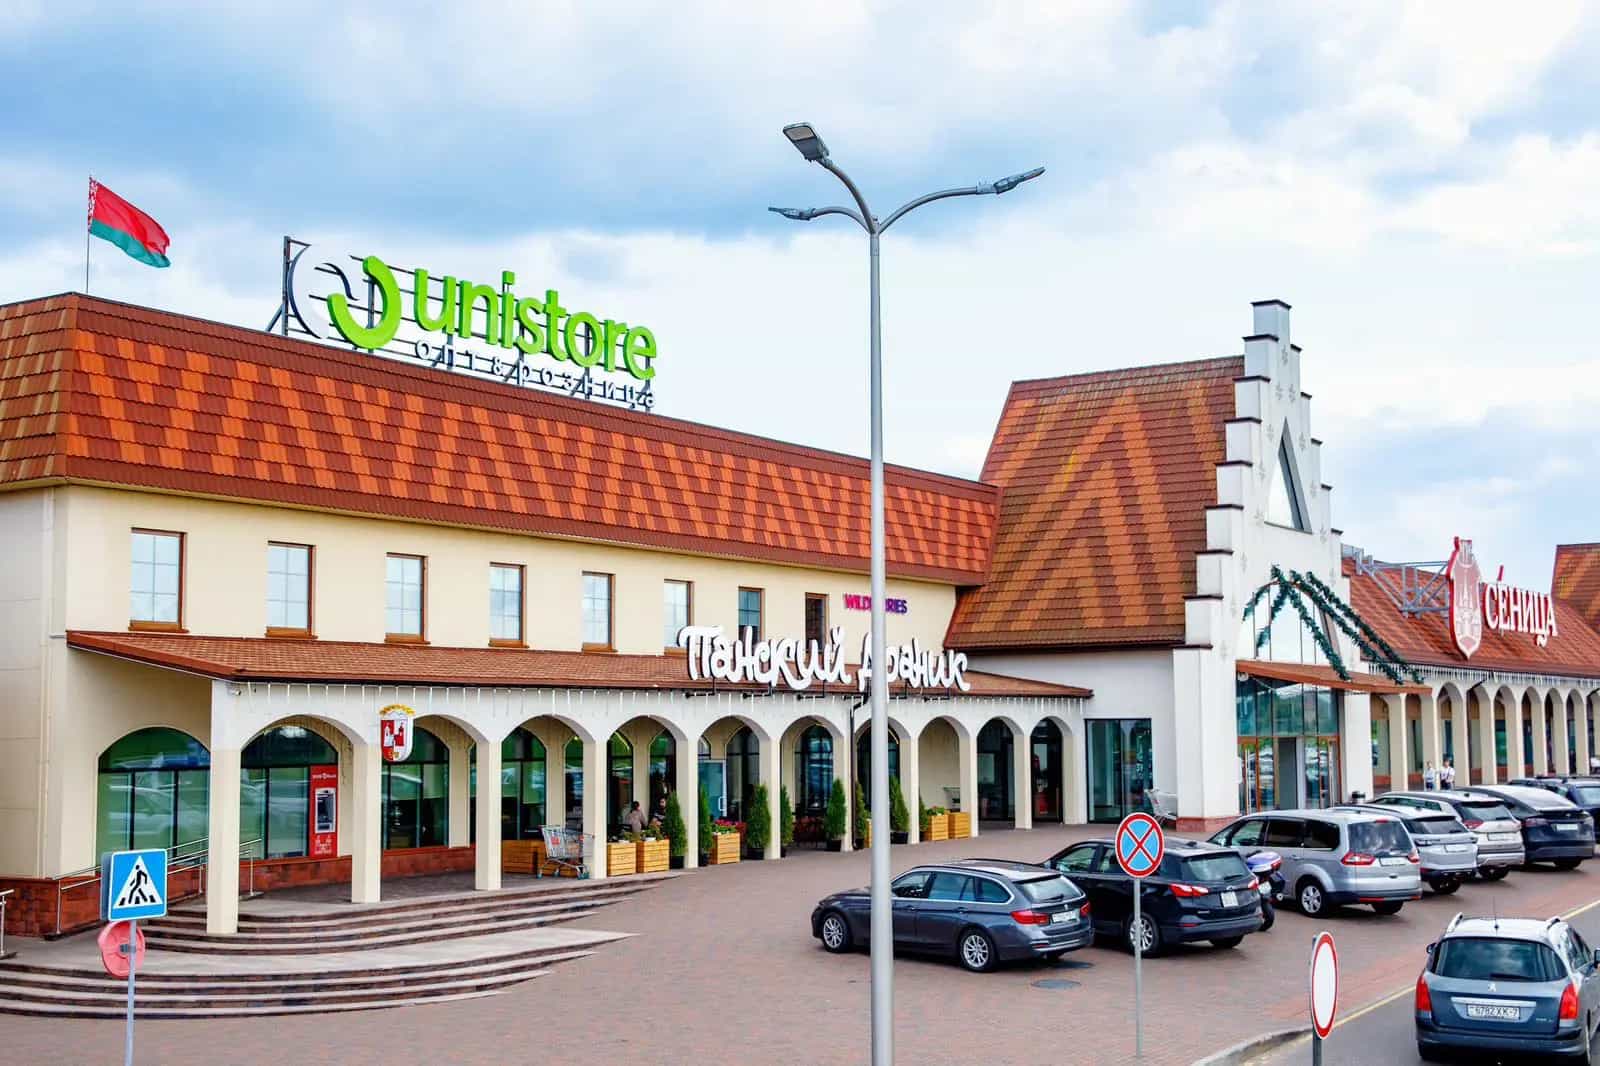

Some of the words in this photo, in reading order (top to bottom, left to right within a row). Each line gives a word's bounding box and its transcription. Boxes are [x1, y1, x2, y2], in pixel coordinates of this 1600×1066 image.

[414, 269, 657, 380] unistore
[844, 593, 907, 613] WILDRIES
[677, 625, 852, 690] Панский
